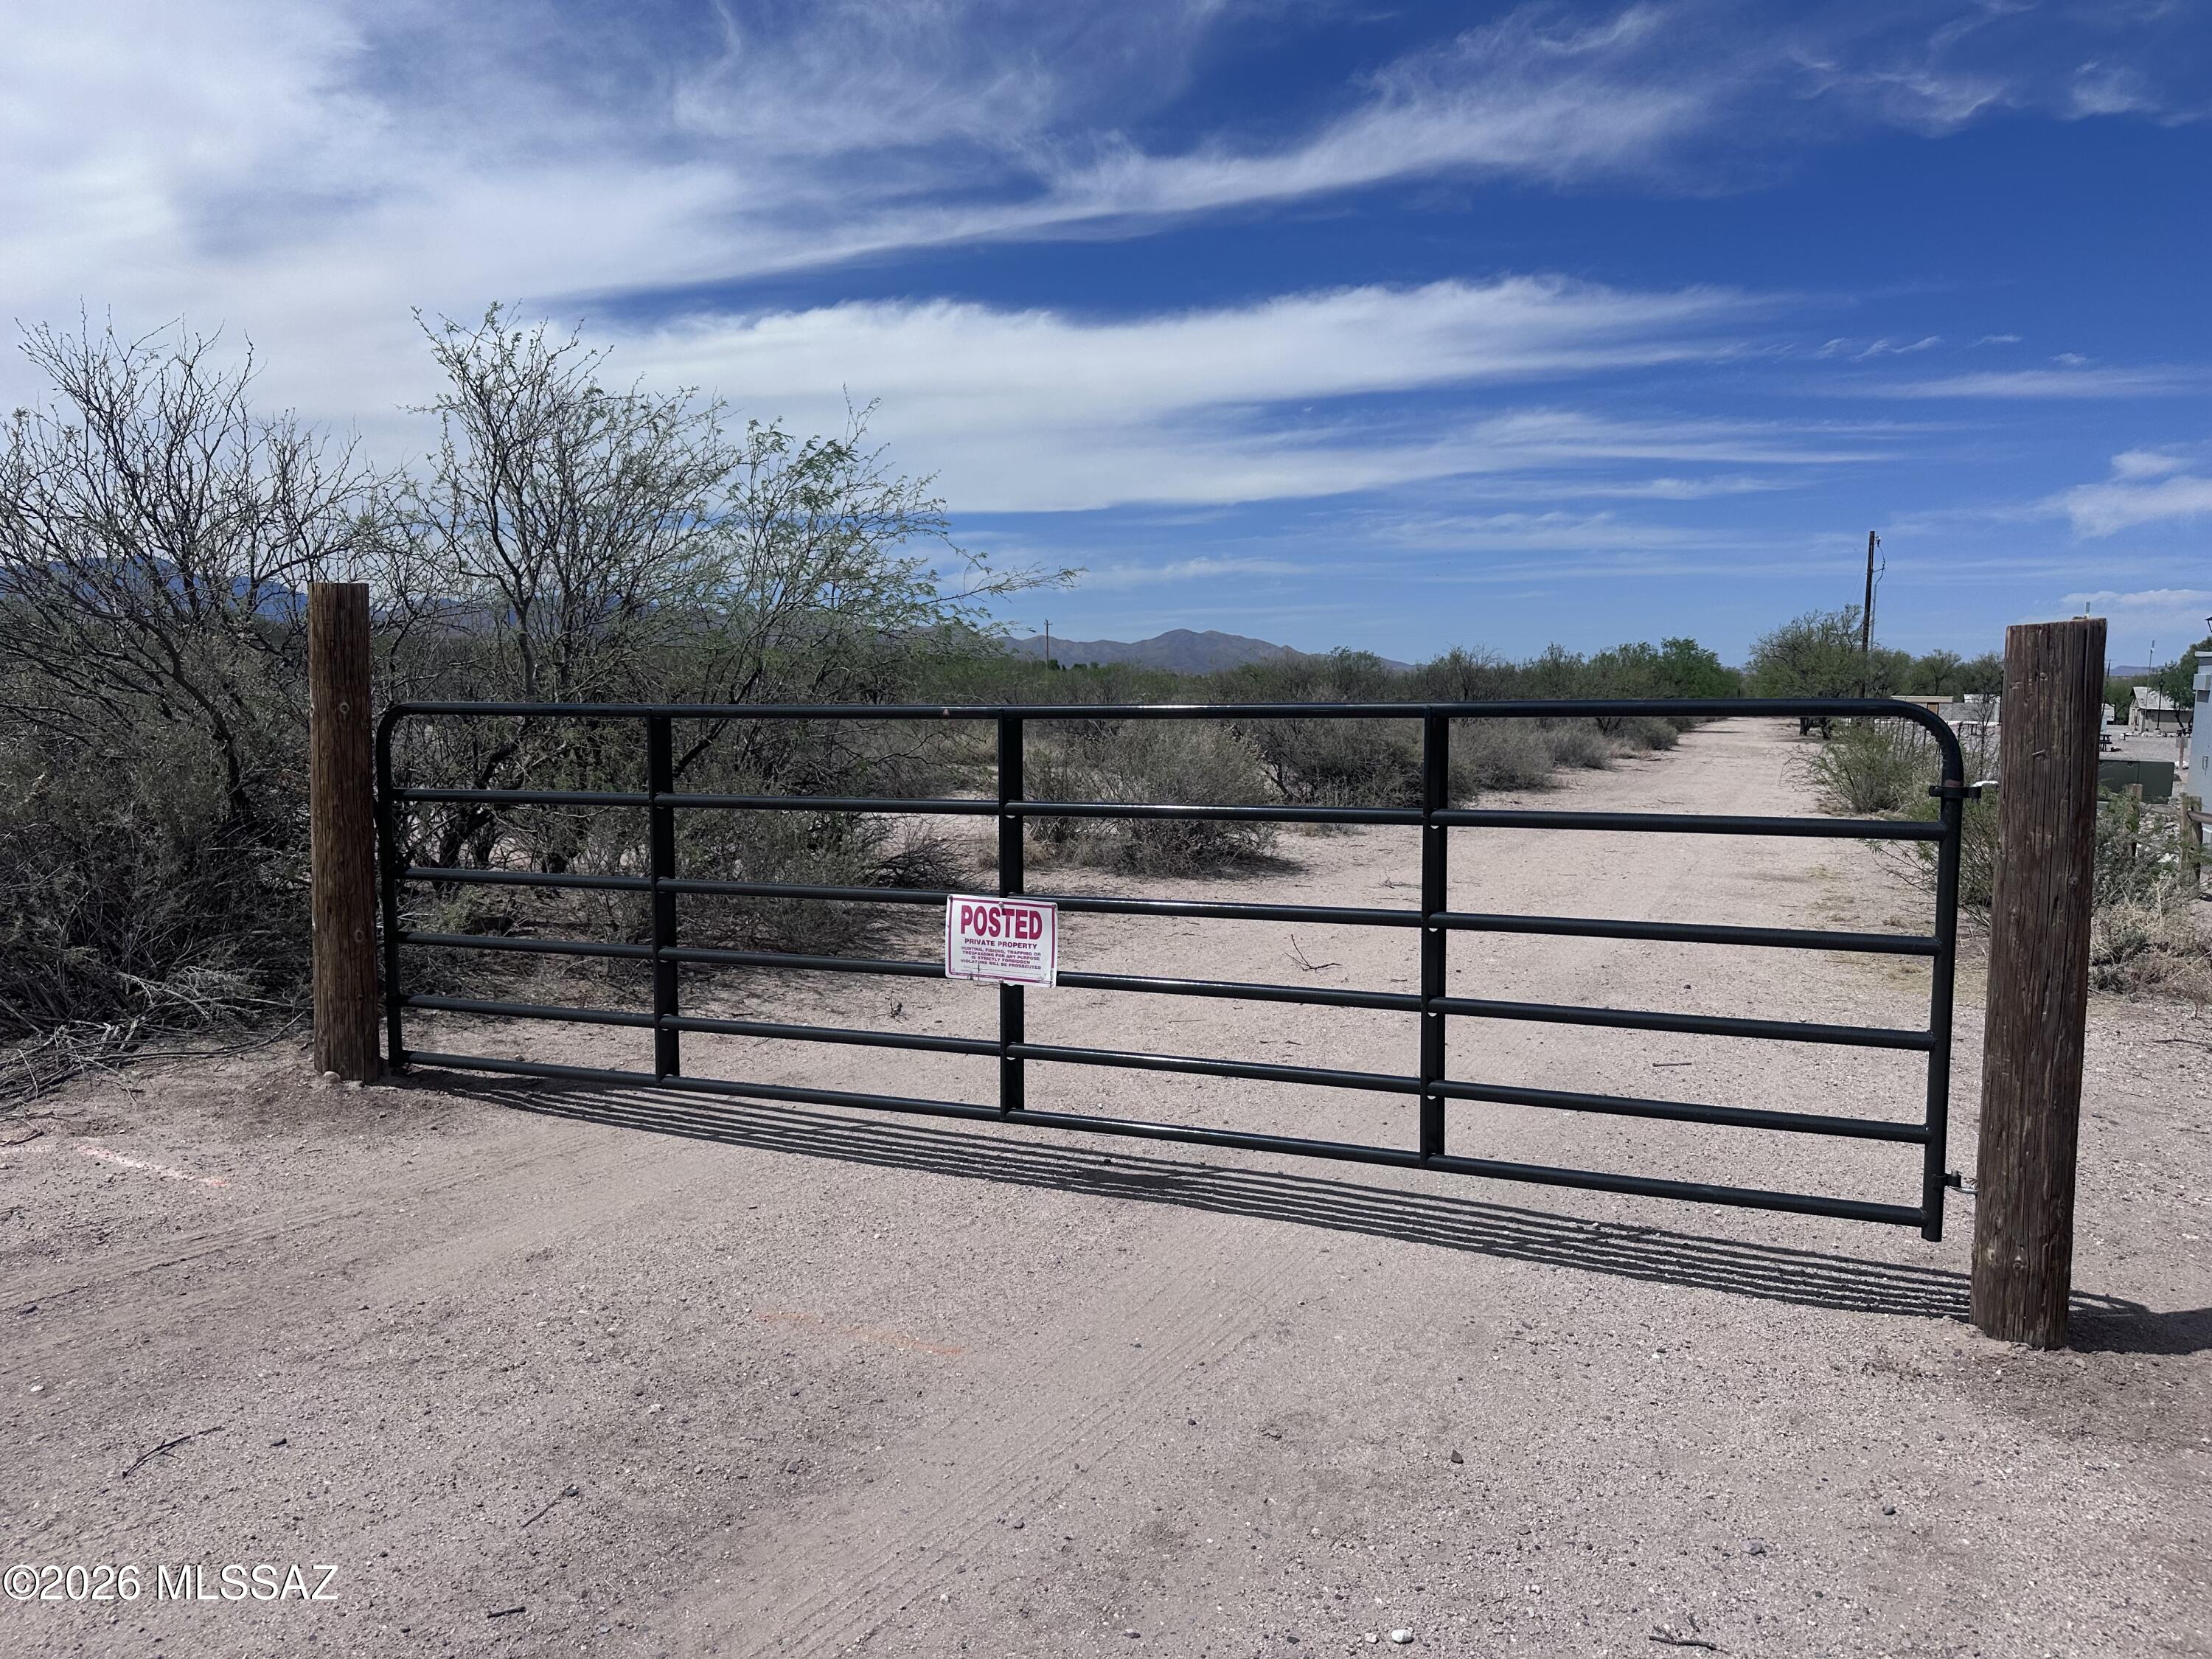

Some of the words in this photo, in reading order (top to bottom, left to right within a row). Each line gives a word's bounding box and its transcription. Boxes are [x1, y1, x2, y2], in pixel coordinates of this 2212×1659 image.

[961, 905, 1043, 940] POSTED
[964, 938, 995, 946] PRIVATE
[998, 941, 1037, 950] PROPERTY
